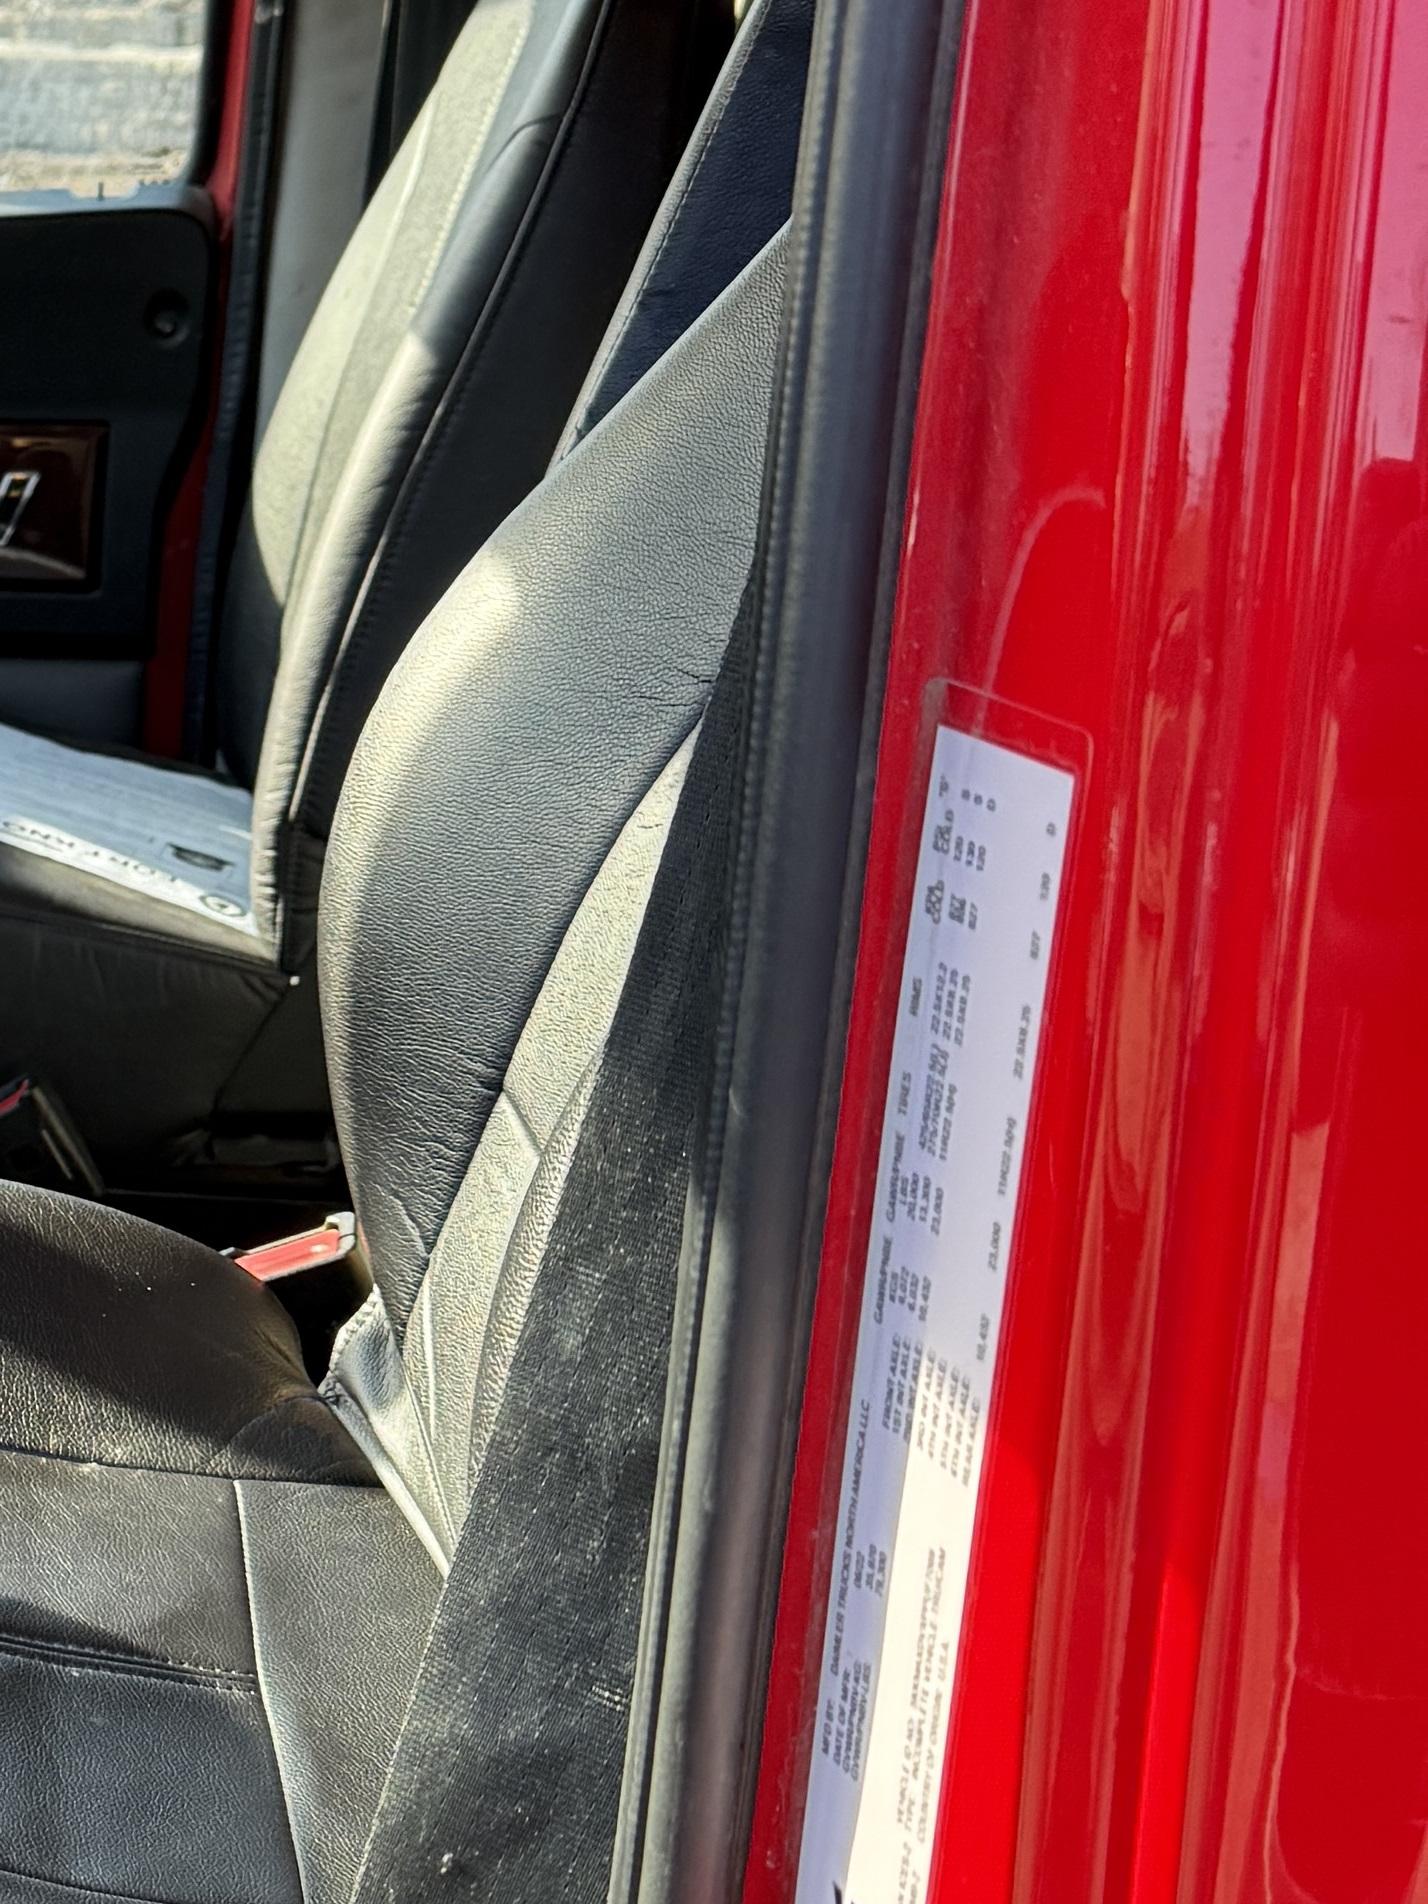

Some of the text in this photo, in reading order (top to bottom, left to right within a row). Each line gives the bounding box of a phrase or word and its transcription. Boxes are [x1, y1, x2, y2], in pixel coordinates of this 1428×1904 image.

[897, 1069, 911, 1118] TIRES
[850, 1427, 867, 1499] AMERICA
[844, 1493, 859, 1551] NORTH
[837, 1548, 852, 1608] TRUCKS
[829, 1609, 845, 1677] DAIMLER
[836, 1703, 847, 1728] OF
[832, 1725, 844, 1768] DATE
